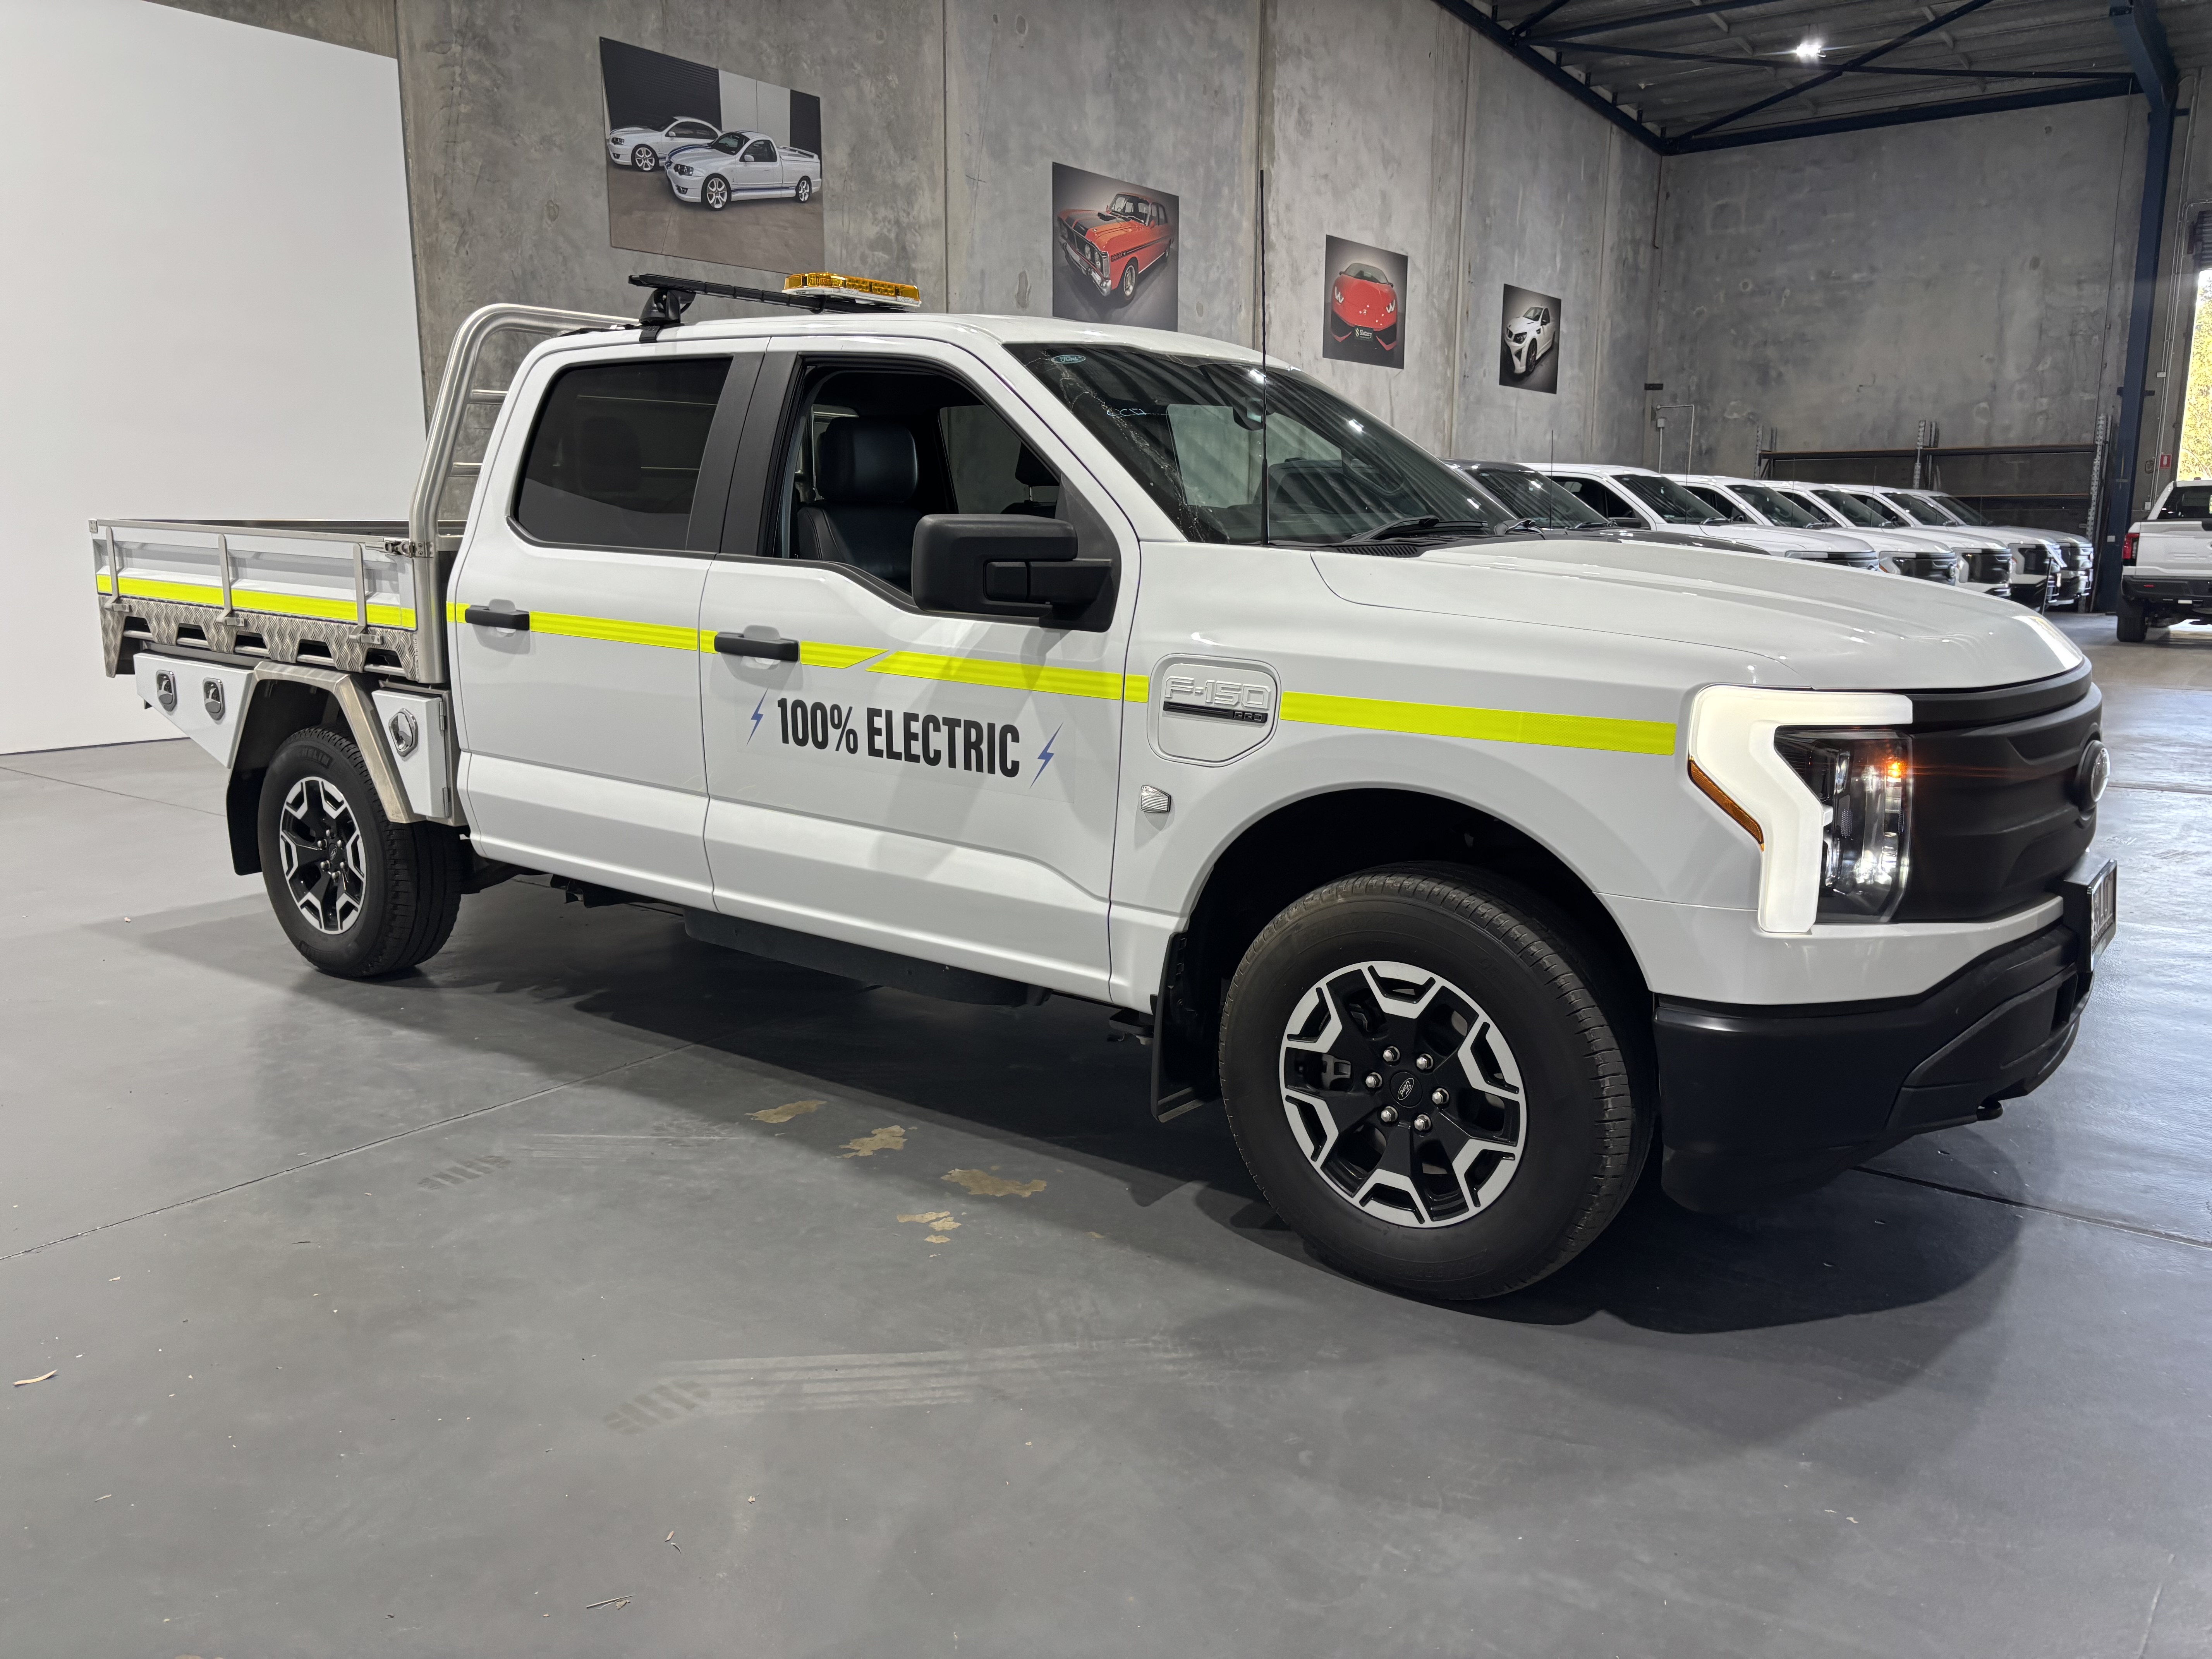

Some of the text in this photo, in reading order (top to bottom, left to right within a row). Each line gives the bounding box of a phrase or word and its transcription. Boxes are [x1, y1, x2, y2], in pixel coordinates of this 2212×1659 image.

[1164, 675, 1271, 710] F-150
[1233, 711, 1262, 722] PRO
[777, 697, 1020, 778] 100% ELECTRIC
[1399, 1080, 1412, 1097] Ford
